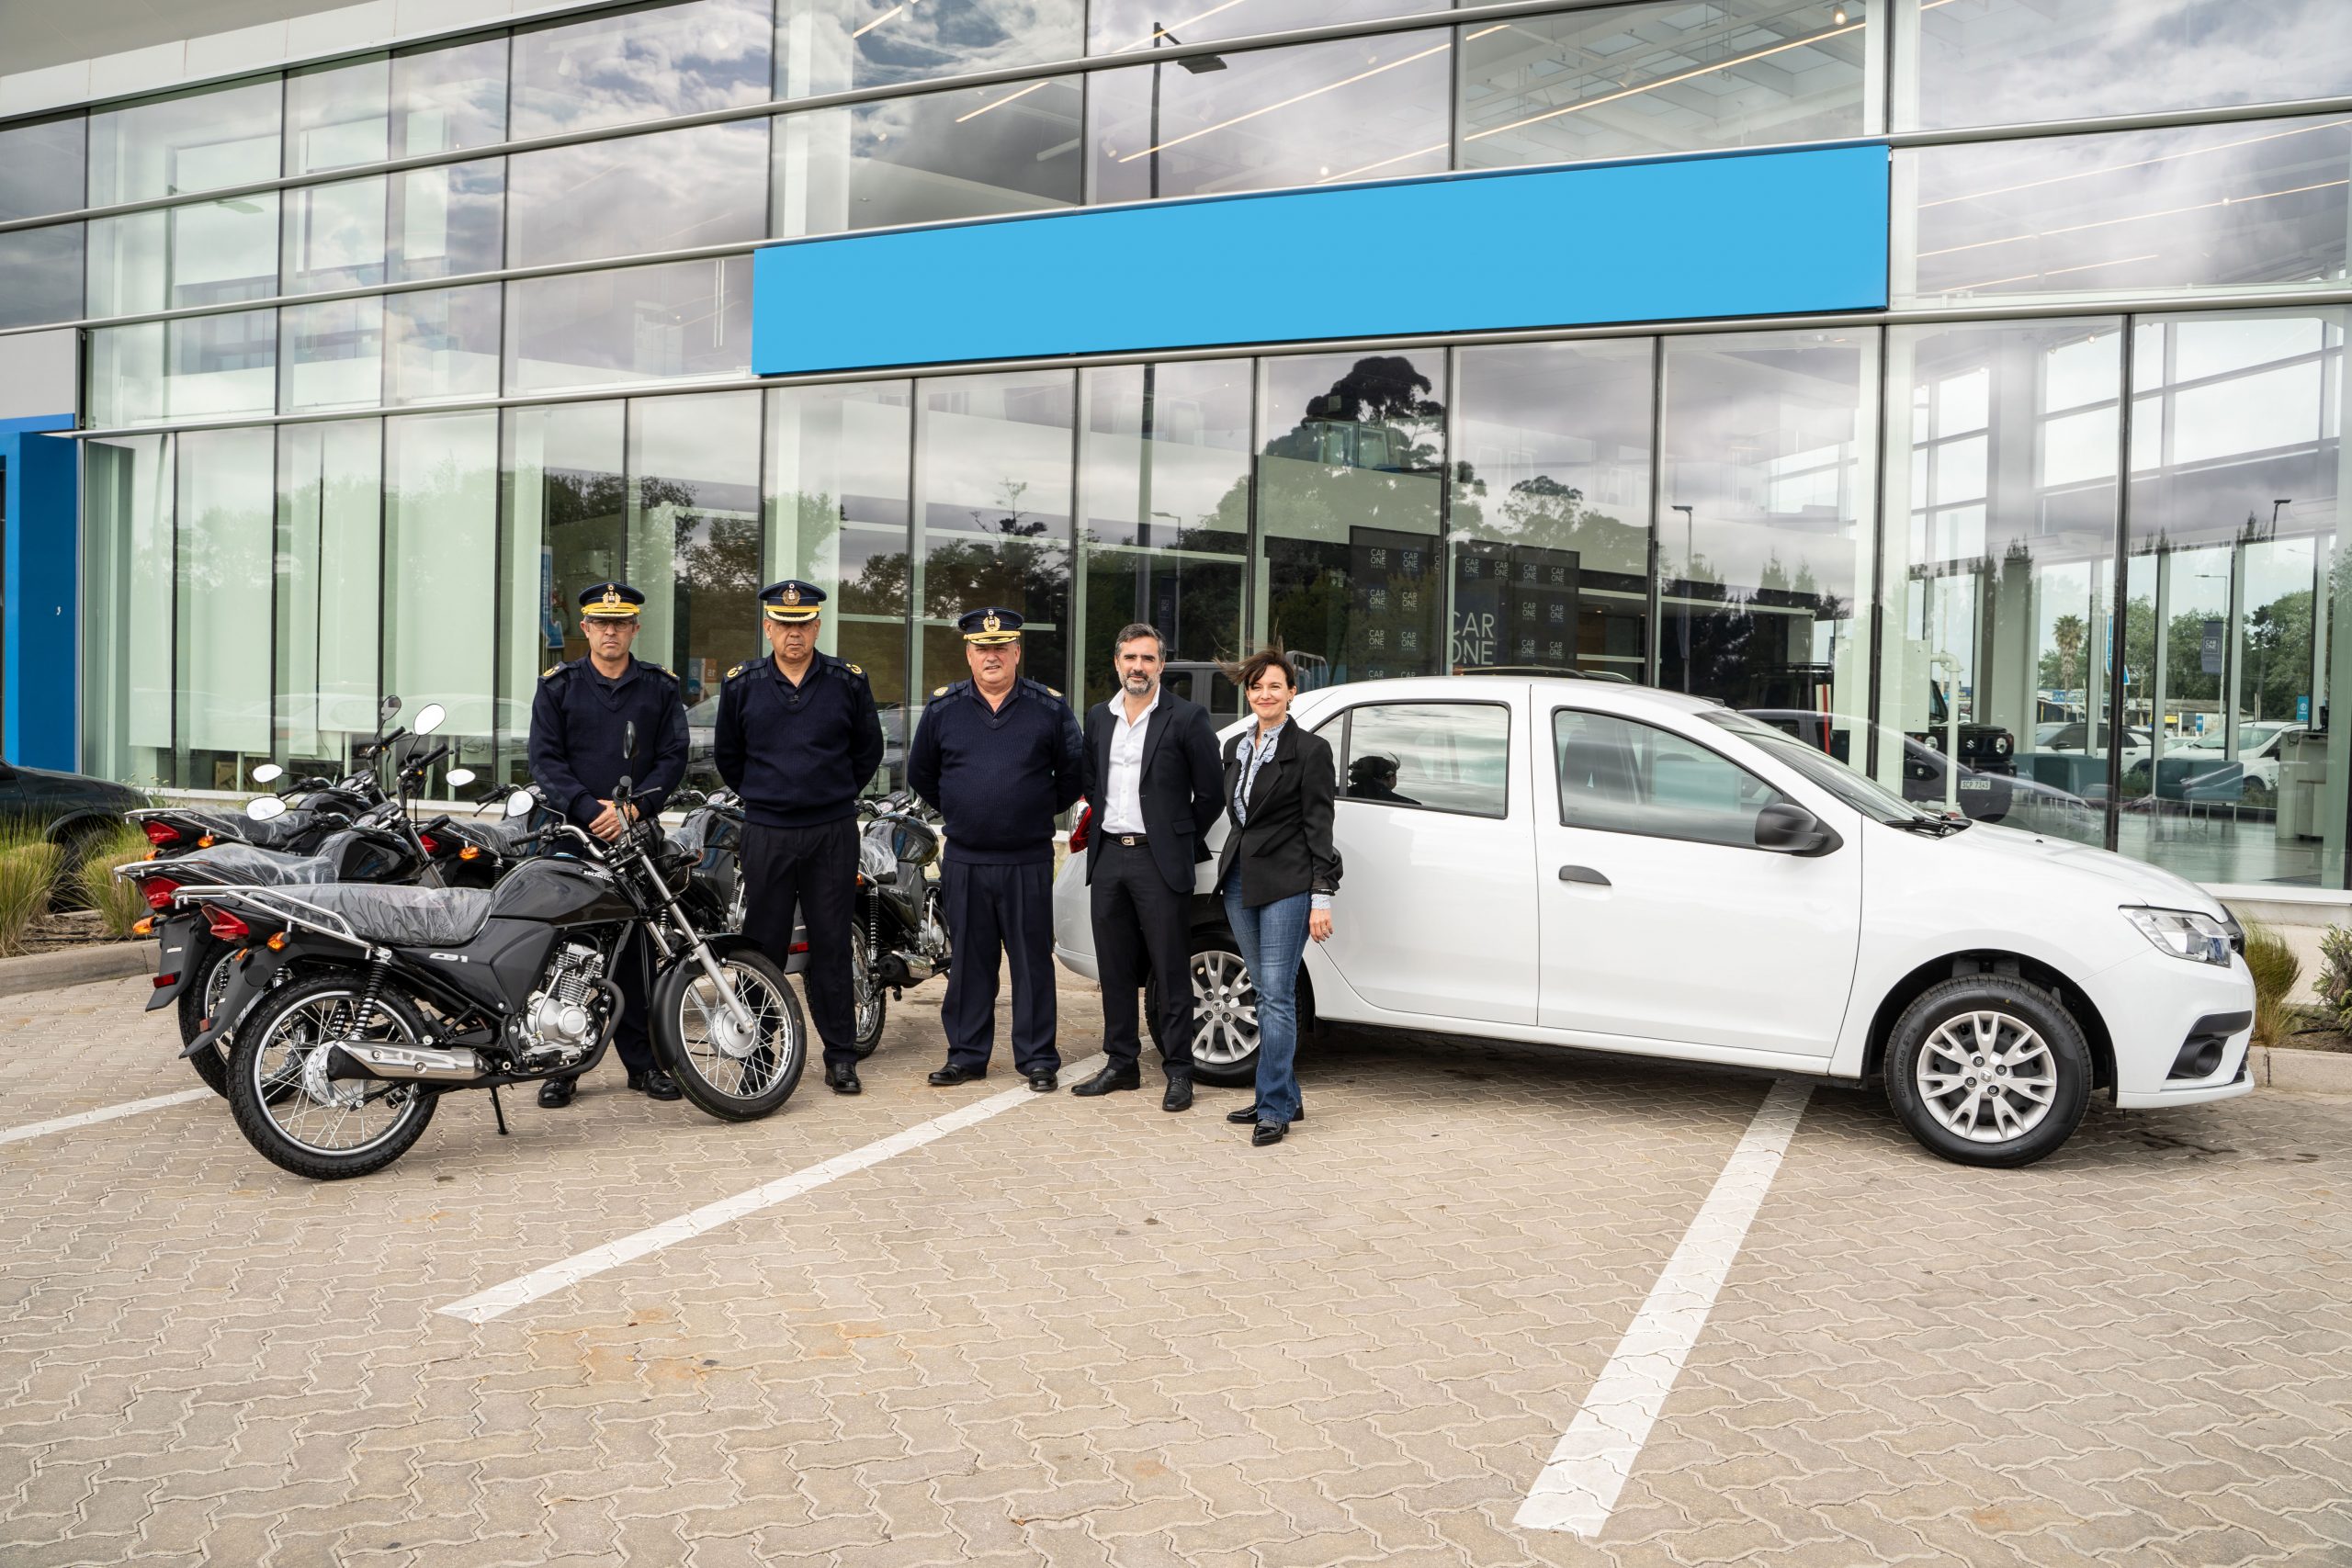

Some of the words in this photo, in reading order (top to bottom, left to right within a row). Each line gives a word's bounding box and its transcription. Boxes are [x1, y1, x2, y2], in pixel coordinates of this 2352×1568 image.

[1371, 548, 1385, 557] CAR
[1371, 557, 1385, 565] ONE
[1370, 597, 1385, 605] ONE
[1402, 600, 1417, 608] ONE
[1369, 671, 1384, 679] CAR
[583, 870, 615, 883] HONDA
